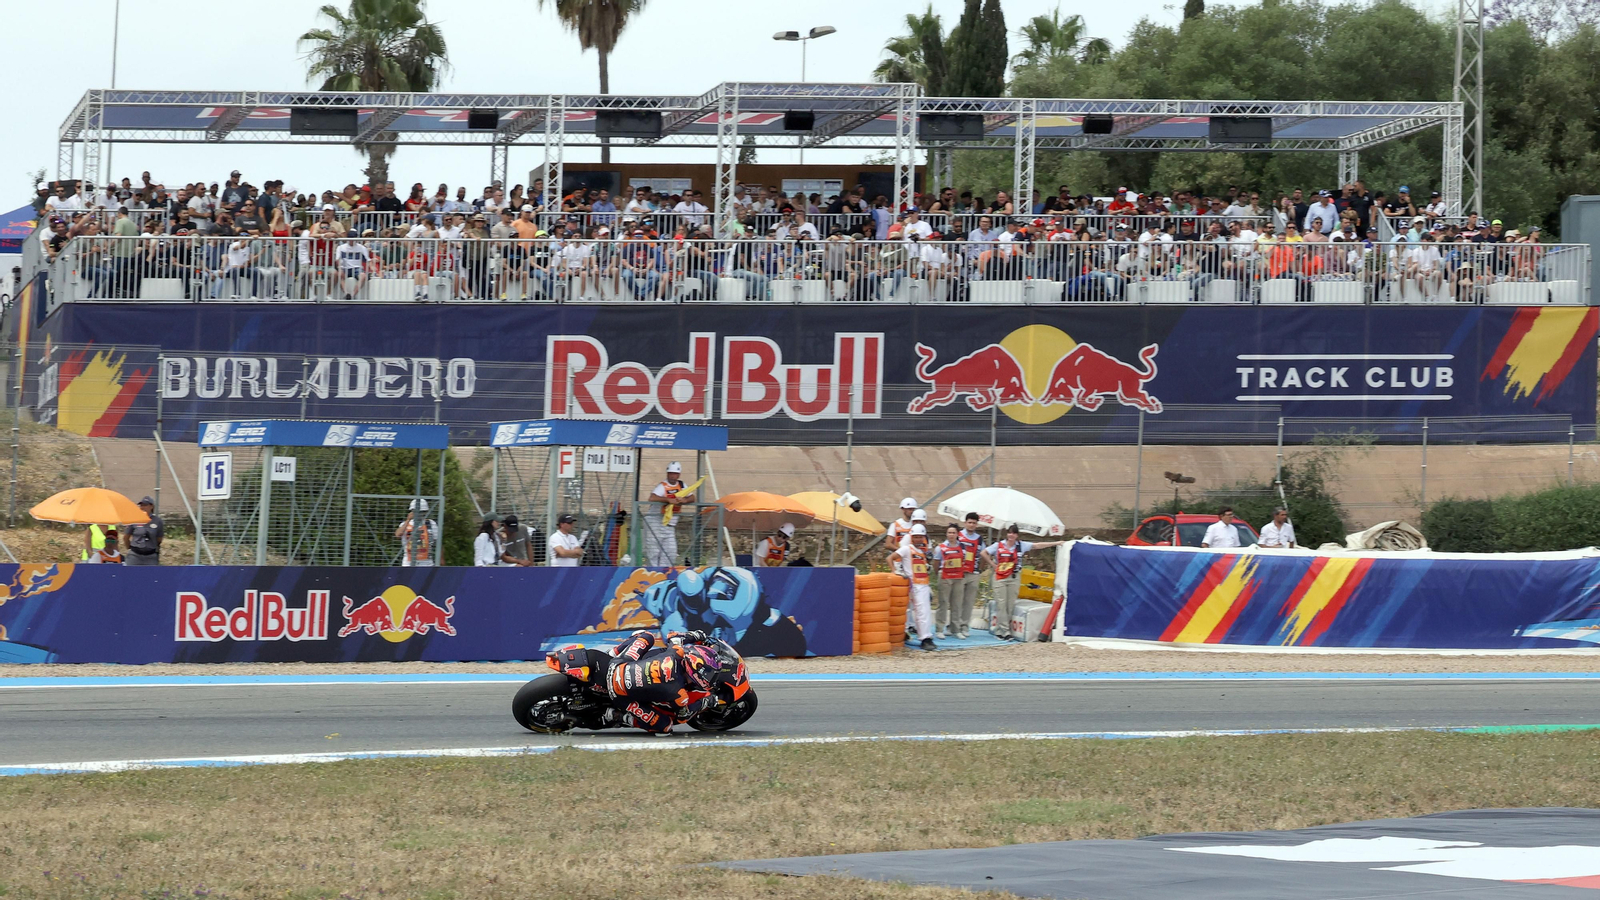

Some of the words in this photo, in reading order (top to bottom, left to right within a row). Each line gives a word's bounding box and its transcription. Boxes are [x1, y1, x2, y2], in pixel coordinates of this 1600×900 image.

[161, 357, 475, 399] BURLADERO
[544, 332, 716, 419] Red
[721, 332, 885, 422] Bull
[1236, 366, 1349, 388] TRACK
[1365, 366, 1454, 388] CLUB
[229, 427, 267, 436] JEREZ
[356, 431, 398, 440] JEREZ
[518, 427, 552, 437] JEREZ
[637, 430, 678, 440] JEREZ
[274, 462, 292, 473] LC11
[560, 451, 573, 474] F
[205, 461, 225, 490] 15
[175, 589, 258, 642] Red
[258, 590, 330, 642] Bull
[625, 640, 647, 662] Bull
[626, 701, 655, 724] Red
